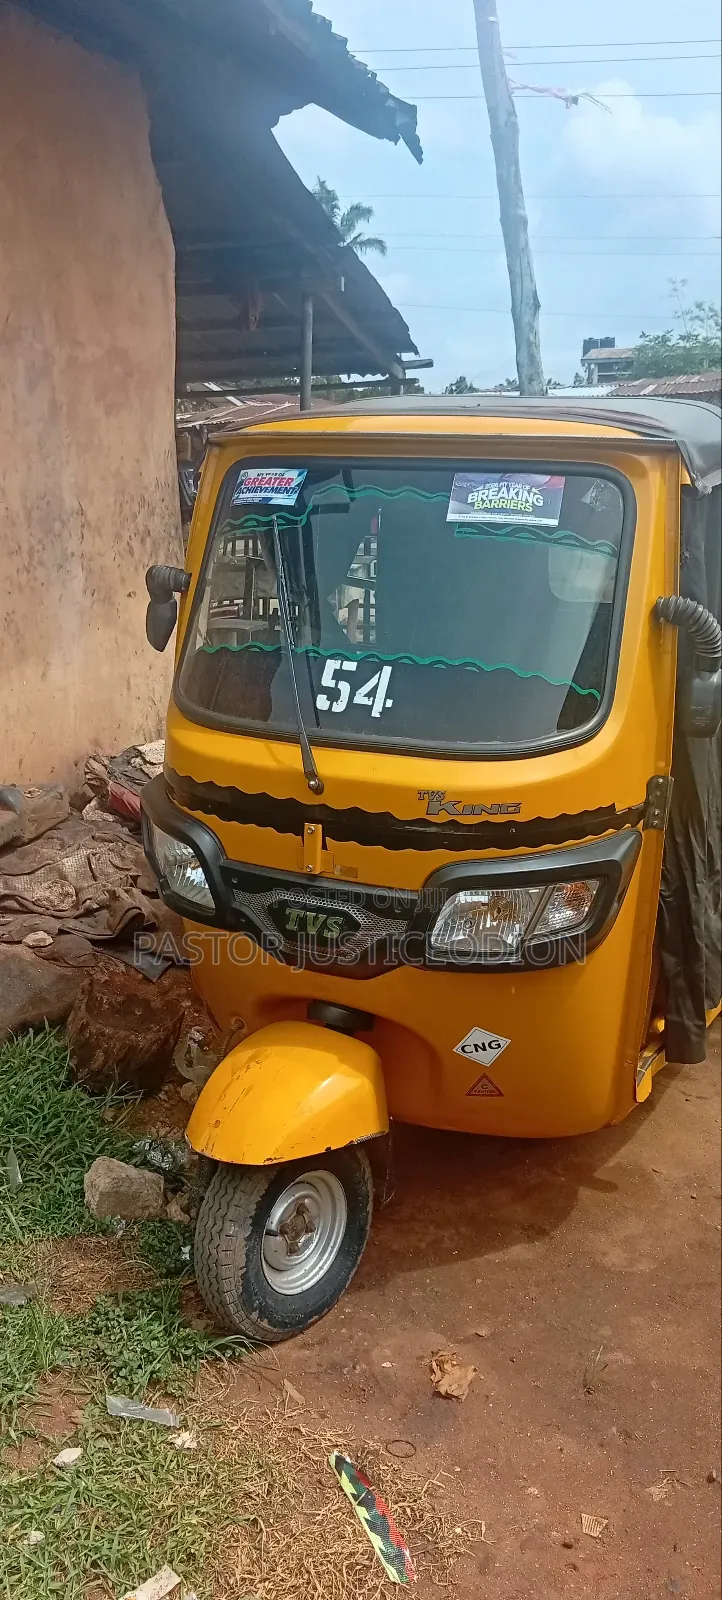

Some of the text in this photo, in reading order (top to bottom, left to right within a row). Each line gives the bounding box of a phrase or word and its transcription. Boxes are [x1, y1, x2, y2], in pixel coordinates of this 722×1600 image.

[243, 477, 295, 486] GREATER
[467, 487, 544, 507] BREAKING
[473, 499, 533, 512] BARRIERS
[316, 659, 393, 717] 54
[418, 789, 447, 801] TVS
[285, 908, 345, 938] TVS
[461, 1040, 501, 1054] CNG
